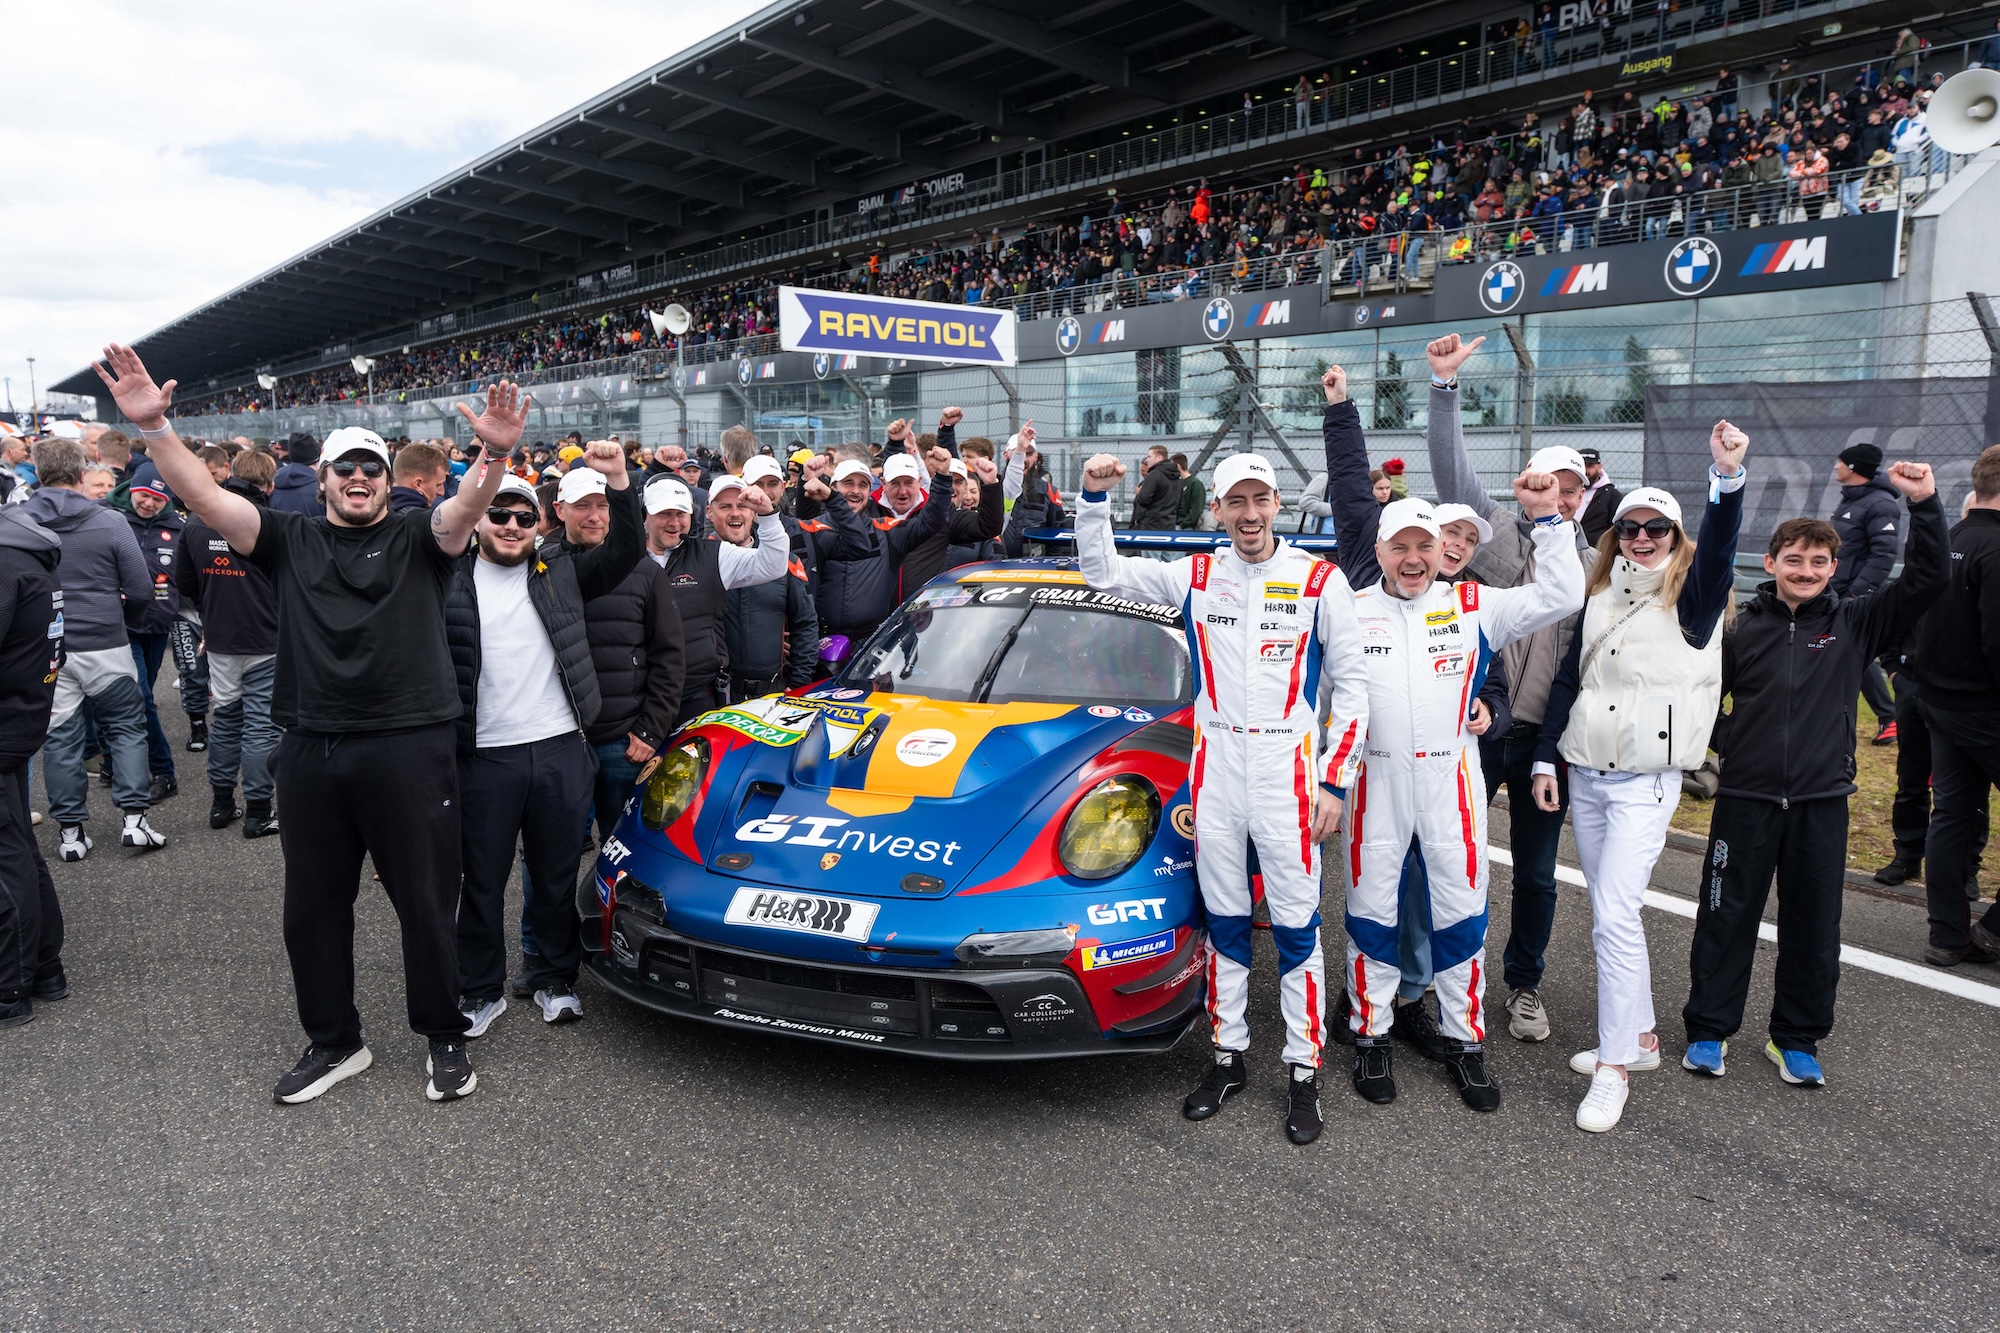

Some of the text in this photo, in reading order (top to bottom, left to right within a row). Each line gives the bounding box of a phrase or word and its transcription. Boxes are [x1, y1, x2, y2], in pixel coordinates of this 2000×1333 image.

[1622, 54, 1673, 76] Ausgang
[858, 194, 885, 216] BMW
[819, 309, 987, 348] RAVENOL
[208, 539, 228, 547] MASCO
[975, 572, 1083, 581] PORSC
[1311, 562, 1330, 590] sparco
[1030, 587, 1182, 619] GRAN TURISMO
[1075, 601, 1115, 611] DRIVING
[1117, 606, 1174, 625] SIMULATOR
[1264, 602, 1284, 613] H&R
[1207, 614, 1238, 626] GRT
[1260, 622, 1299, 632] GInvest
[1429, 628, 1449, 637] H&R
[725, 714, 788, 744] DEKRA
[1208, 720, 1230, 729] sparco
[601, 835, 632, 866] GRT
[735, 814, 962, 866] GInvest
[748, 893, 816, 924] H&R
[1086, 898, 1167, 926] GRT
[1112, 939, 1167, 959] MICHELIN
[1031, 1008, 1075, 1018] COLLECTION
[1037, 1002, 1052, 1010] CC
[714, 1008, 885, 1042] Porsche Zentrum Mainz
